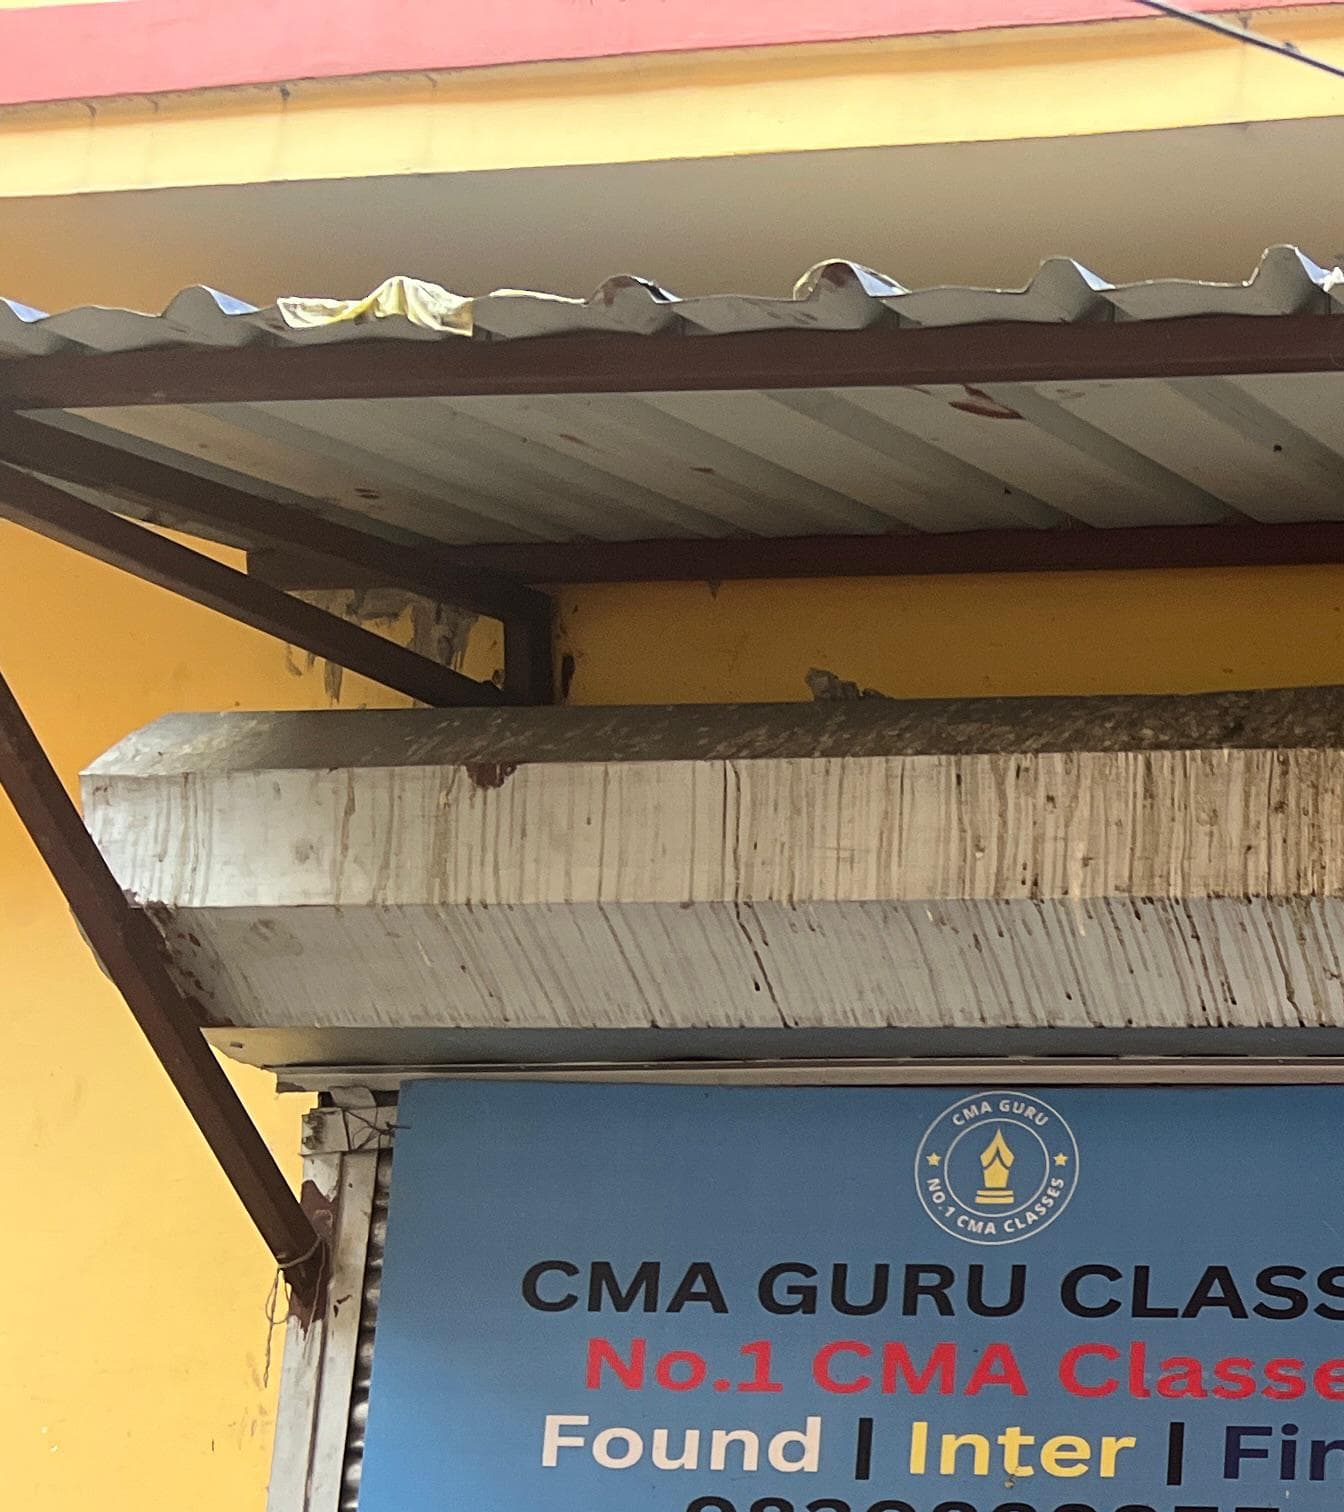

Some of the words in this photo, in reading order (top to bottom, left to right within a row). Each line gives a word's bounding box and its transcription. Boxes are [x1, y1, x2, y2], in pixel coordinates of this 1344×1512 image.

[952, 1101, 992, 1126] CMA
[999, 1099, 1049, 1126] GURU
[956, 1215, 996, 1234] CMA
[1003, 1177, 1065, 1233] CLASSES
[521, 1260, 729, 1314] CMA
[757, 1262, 1027, 1317] GURU
[585, 1337, 783, 1393] No.1
[811, 1341, 1028, 1396] CMA
[541, 1414, 822, 1473] Found
[909, 1421, 1136, 1477] Inter
